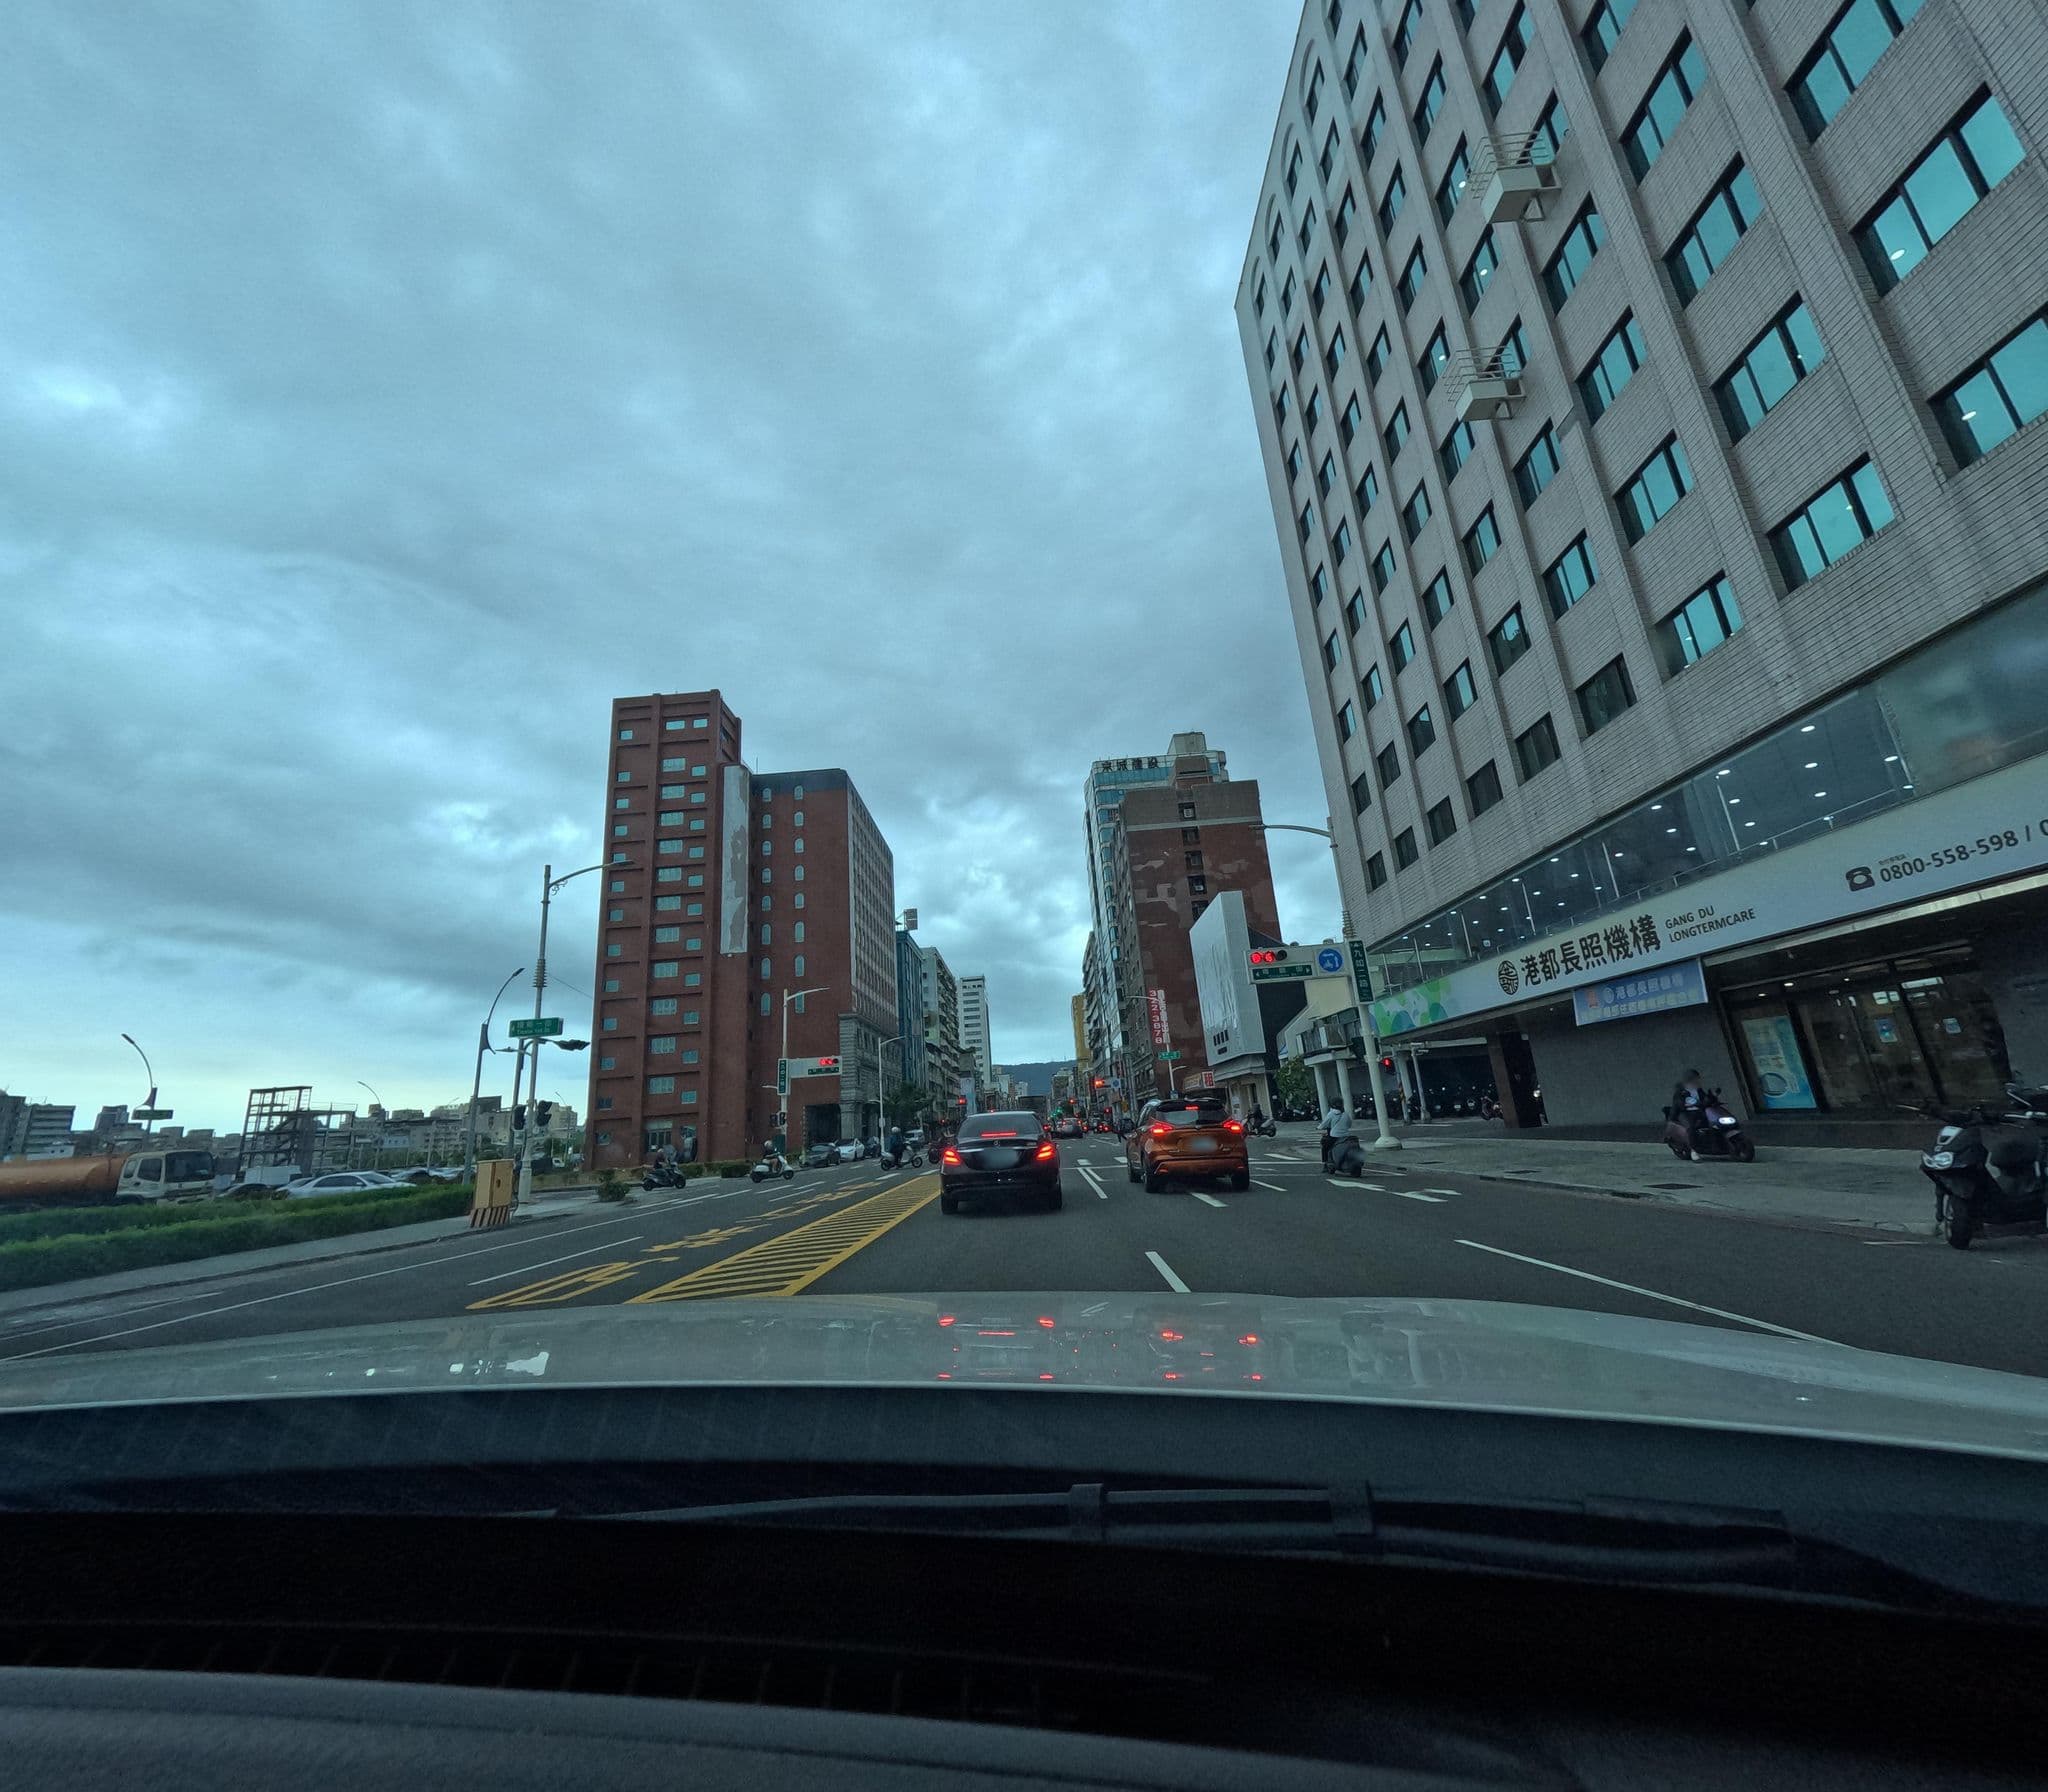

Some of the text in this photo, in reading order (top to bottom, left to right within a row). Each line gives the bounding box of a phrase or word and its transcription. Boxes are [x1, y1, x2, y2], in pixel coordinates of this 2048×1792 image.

[1880, 830, 2019, 882] 0800-558-598
[1664, 905, 1715, 930] GANG DU
[1668, 908, 1756, 943] LONGTERMCARE
[1519, 914, 1662, 987] 港都長照機構
